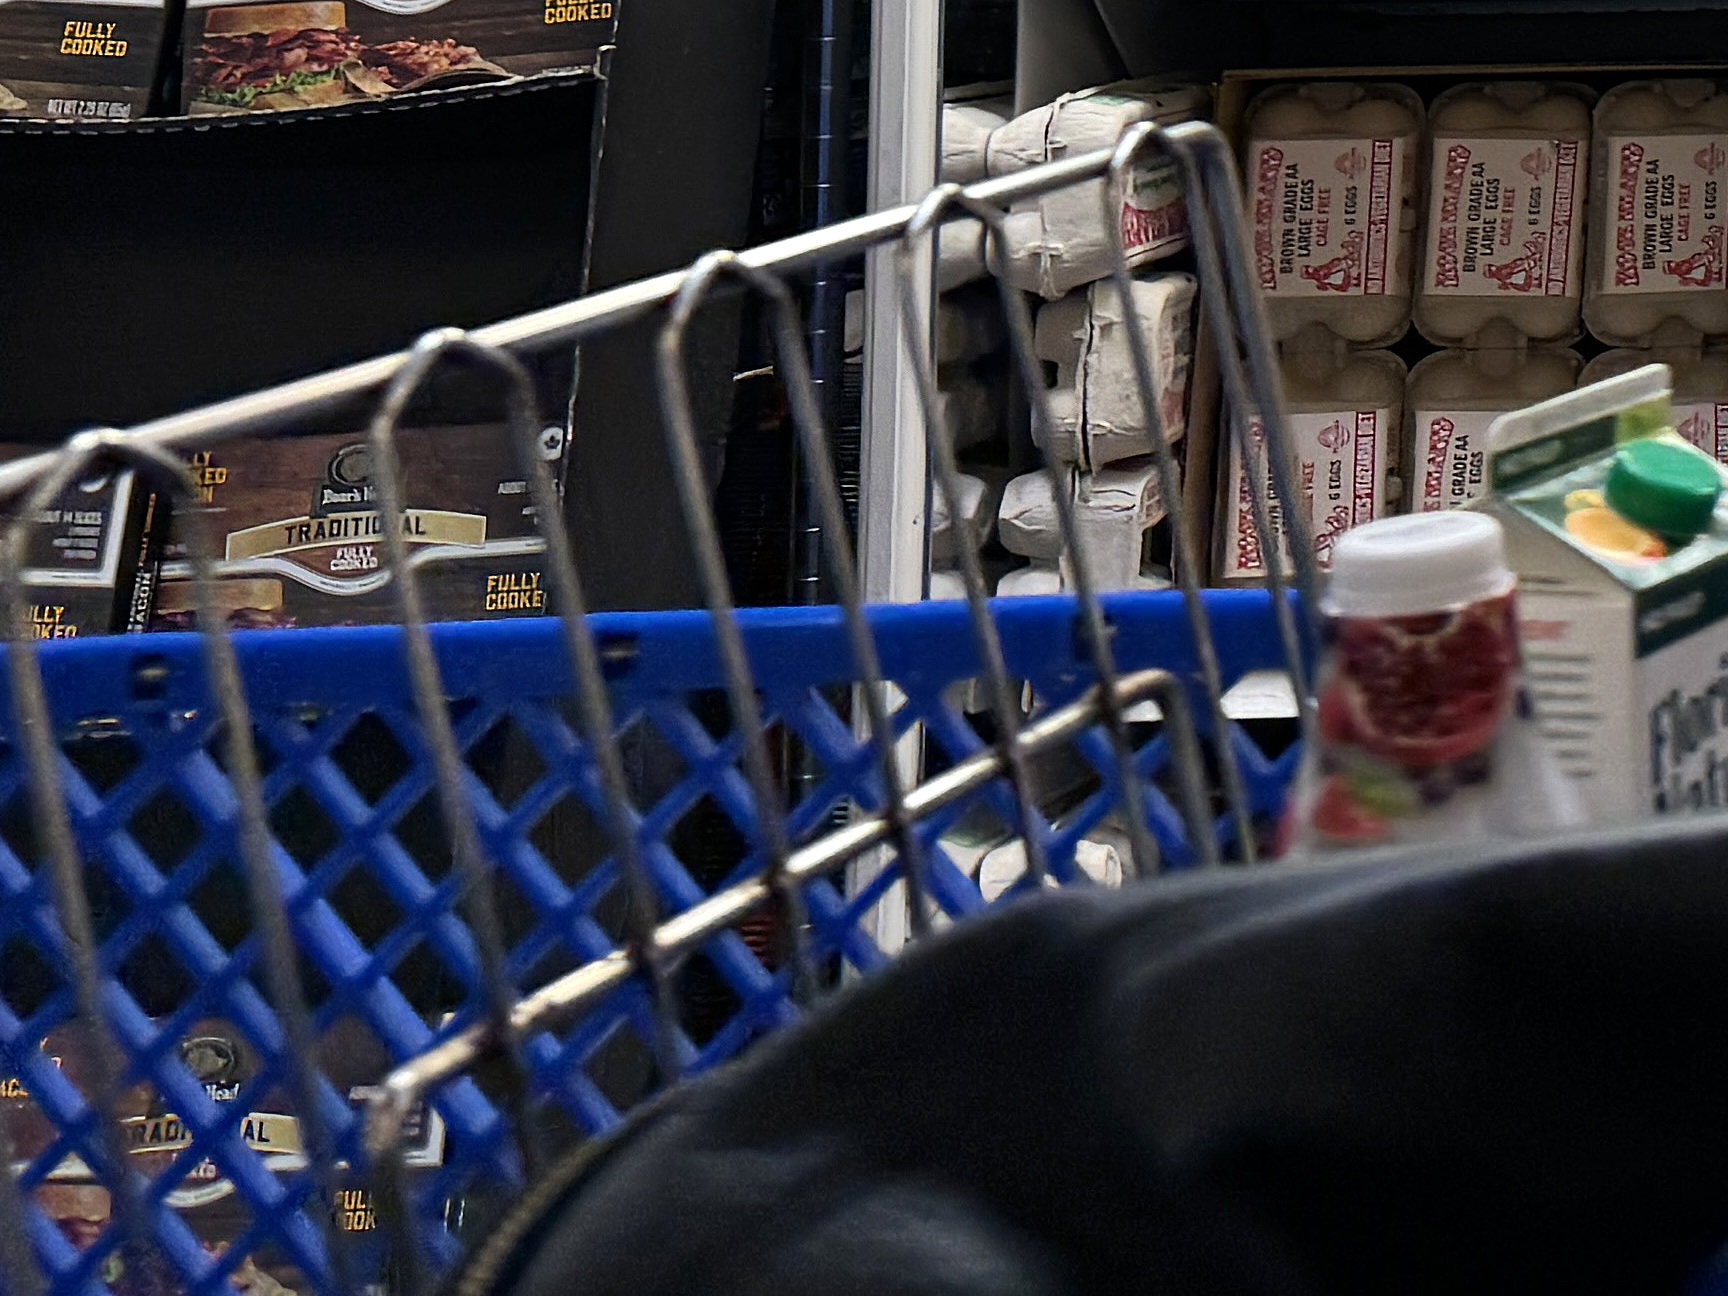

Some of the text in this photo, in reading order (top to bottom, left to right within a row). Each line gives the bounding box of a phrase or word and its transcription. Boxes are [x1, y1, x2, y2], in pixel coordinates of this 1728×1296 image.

[544, 3, 612, 24] COOKED
[64, 21, 116, 39] FULLY
[60, 38, 128, 57] COOKED
[1463, 162, 1486, 273] BROWN GRADE AA
[1480, 178, 1500, 256] LARGE EGGS
[284, 515, 428, 546] TRADITIOAL
[487, 573, 542, 593] FULLY
[485, 590, 547, 610] COOKE
